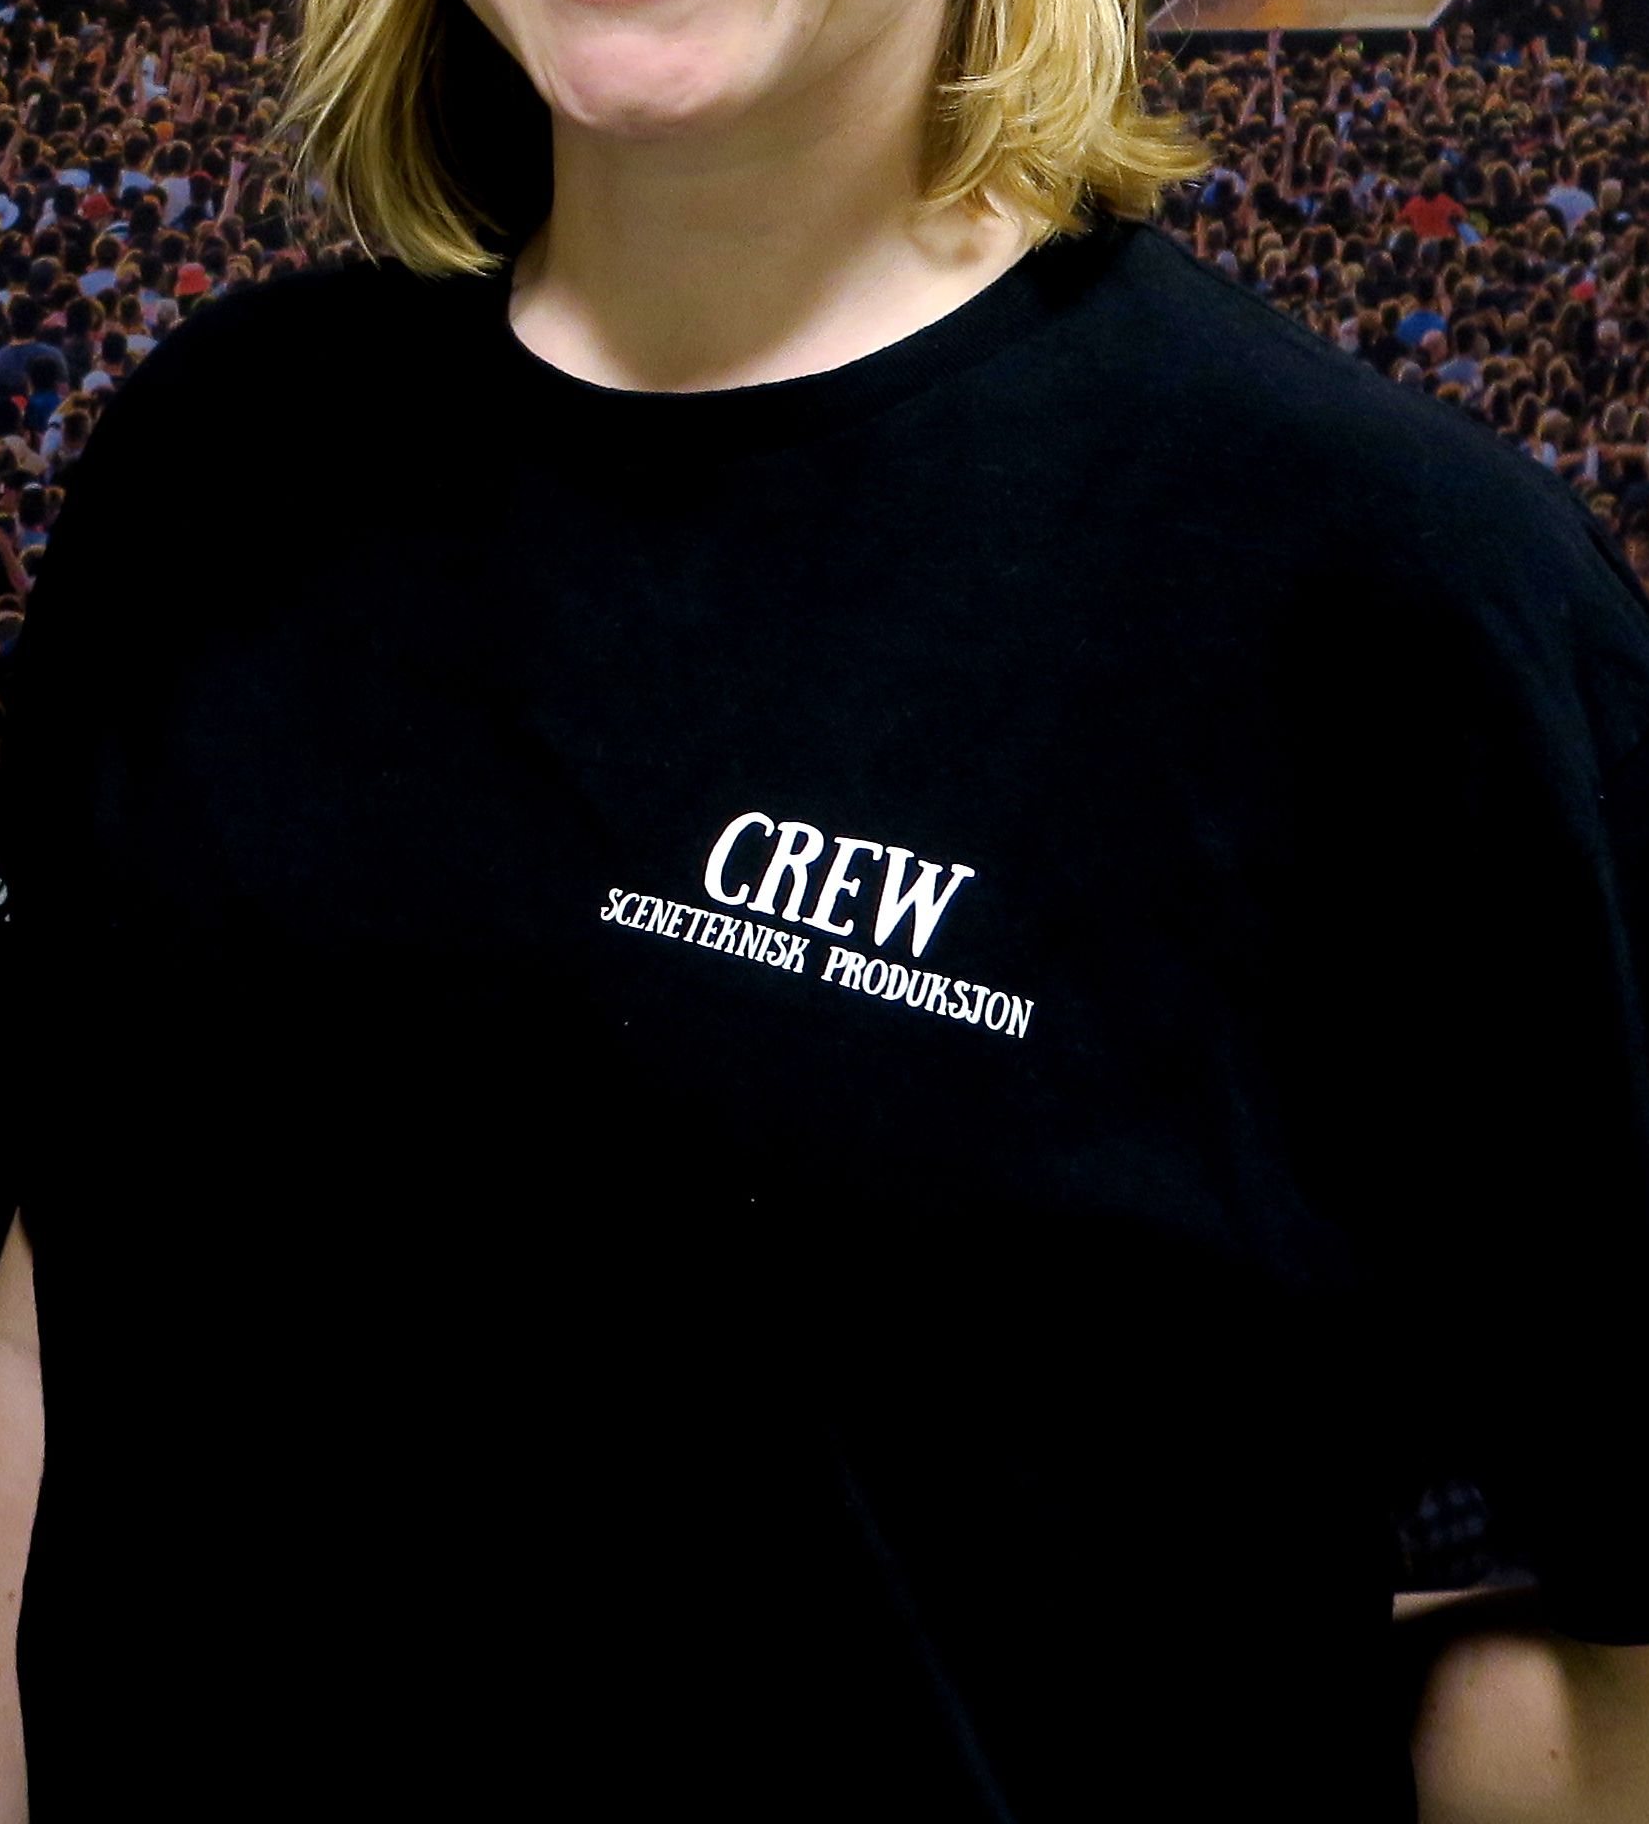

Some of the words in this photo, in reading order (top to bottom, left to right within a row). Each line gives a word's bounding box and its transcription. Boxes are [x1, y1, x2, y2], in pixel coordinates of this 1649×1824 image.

[704, 812, 975, 958] CREW
[600, 888, 811, 973] SCENETEKNISK
[821, 947, 1034, 1038] PRODUKSJON
